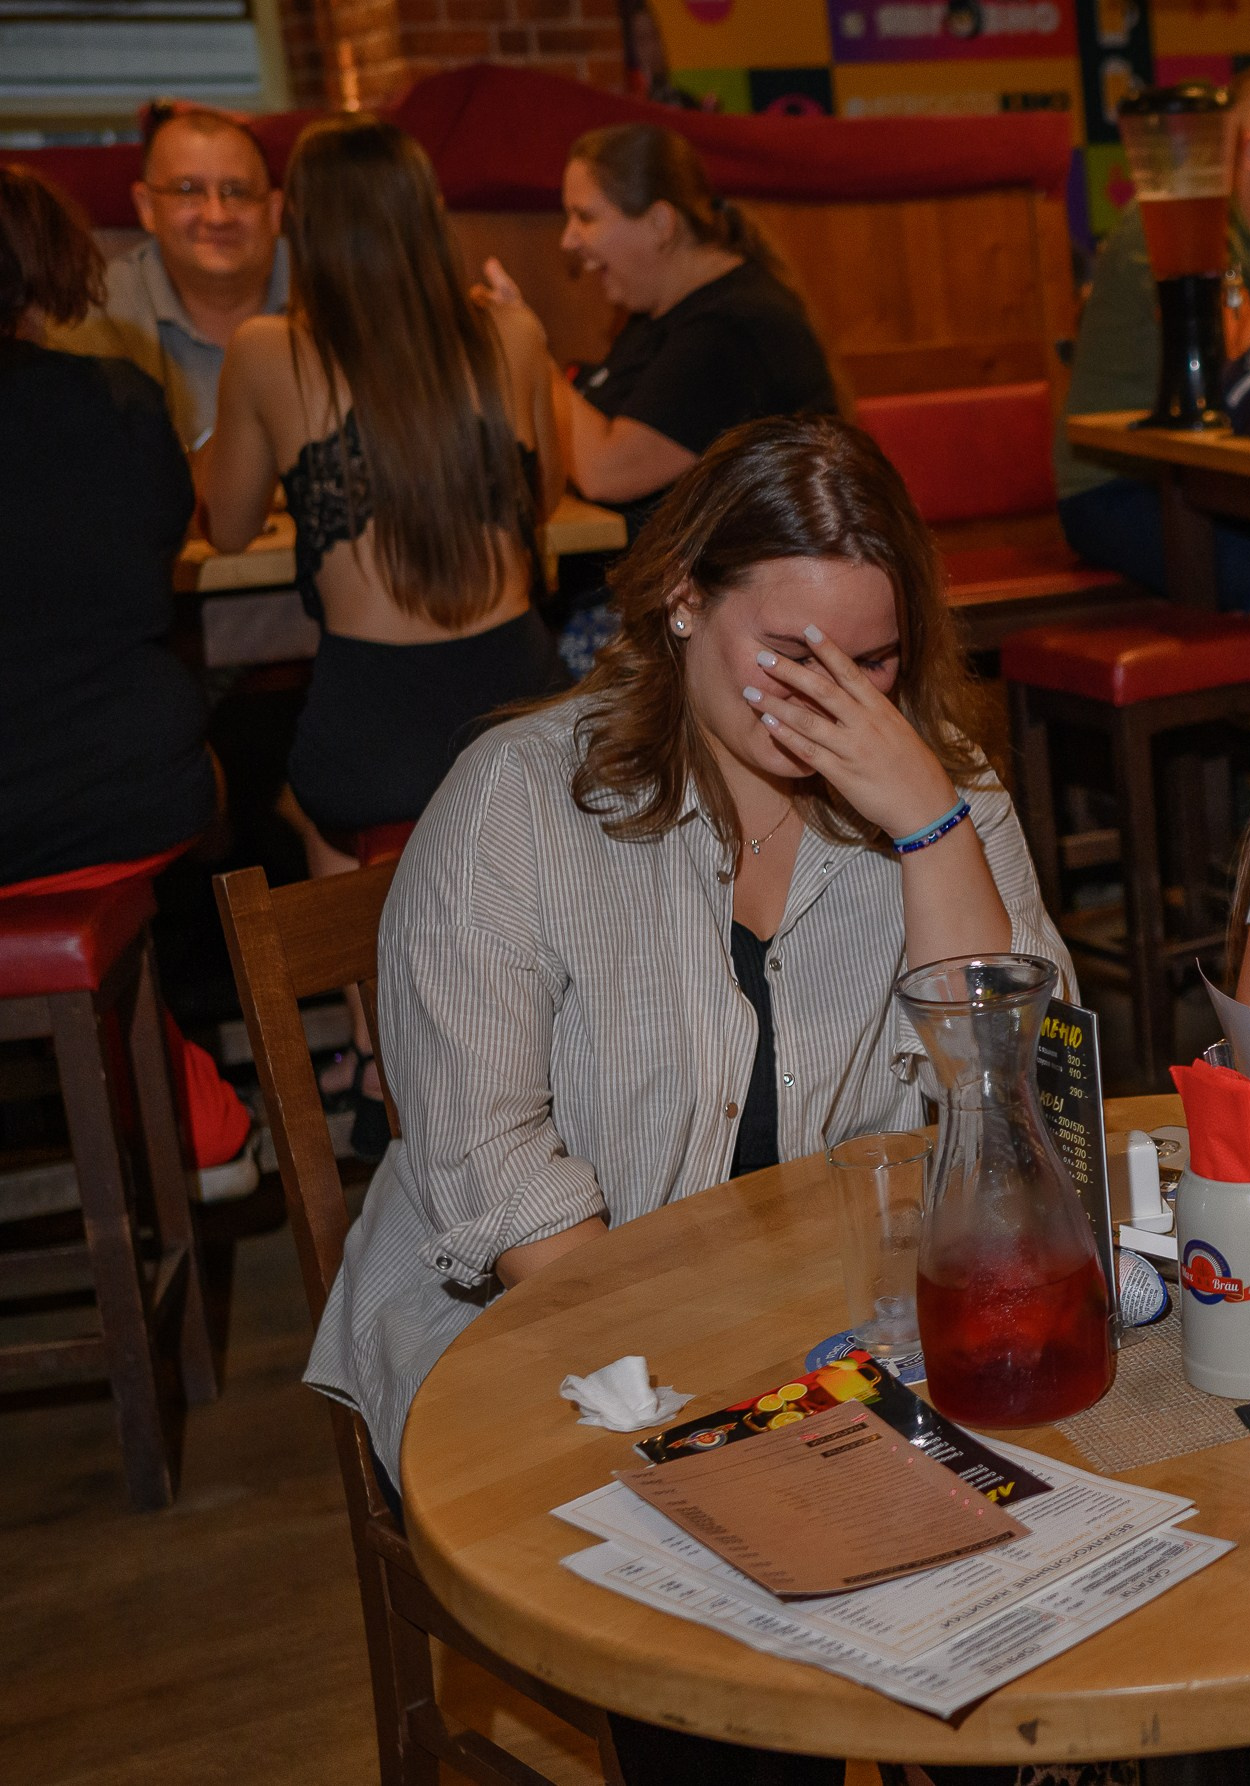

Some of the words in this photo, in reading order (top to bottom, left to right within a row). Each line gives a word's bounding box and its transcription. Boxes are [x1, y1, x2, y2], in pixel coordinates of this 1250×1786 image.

[1067, 1055, 1081, 1067] 320
[1069, 1068, 1082, 1080] 410
[1069, 1086, 1082, 1099] 290
[1074, 1146, 1087, 1159] 270
[1075, 1159, 1088, 1171] 270
[1076, 1171, 1088, 1184] 270
[1212, 1278, 1240, 1292] Bräu
[983, 1481, 1015, 1503] ЛЕ
[1011, 1520, 1136, 1590] БЕЗАЛКОГОЛЬНЫЕ
[1119, 1567, 1170, 1599] САЛАТЫ
[938, 1587, 1012, 1629] НАПИТКИ
